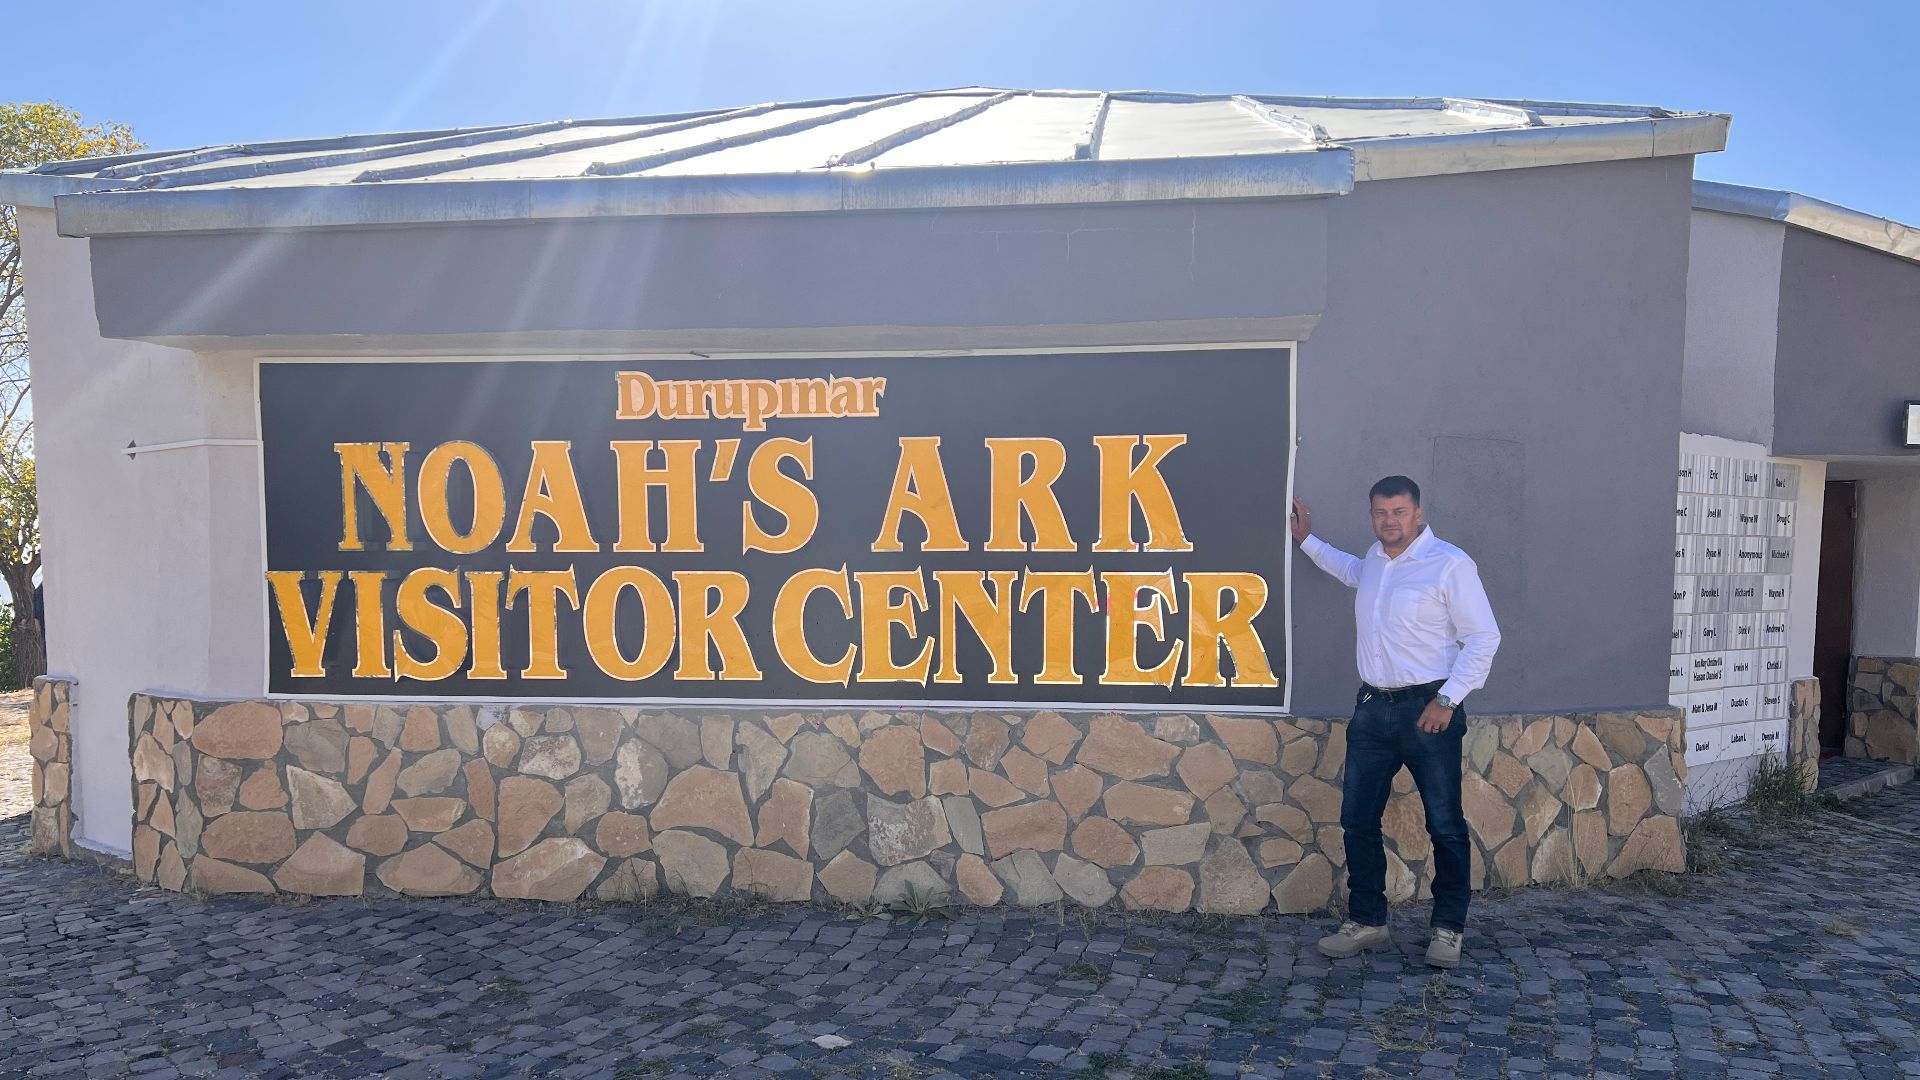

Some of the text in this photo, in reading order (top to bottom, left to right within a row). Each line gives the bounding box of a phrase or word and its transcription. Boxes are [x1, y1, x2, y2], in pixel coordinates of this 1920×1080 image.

[1709, 469, 1718, 479] Eric
[1744, 472, 1753, 482] Luis
[333, 433, 1193, 556] NOAH'S ARK
[1707, 509, 1716, 518] Joel
[1740, 514, 1753, 525] Wayne
[1776, 513, 1786, 525] Doug
[1706, 548, 1717, 560] Ryan
[1738, 550, 1763, 562] Anonymous
[1771, 549, 1786, 559] Michael
[1701, 588, 1716, 598] Brooke
[1735, 588, 1751, 597] Richard
[1768, 589, 1781, 600] Wayne
[265, 562, 1279, 692] VISITOR CENTER
[1766, 624, 1781, 633] Andrew
[1703, 627, 1713, 639] Gary
[1706, 670, 1718, 680] Daniel
[1731, 698, 1744, 708] Dustin
[1764, 696, 1777, 706] Steven
[1731, 734, 1743, 744] Laban
[1695, 741, 1710, 752] Daniel
